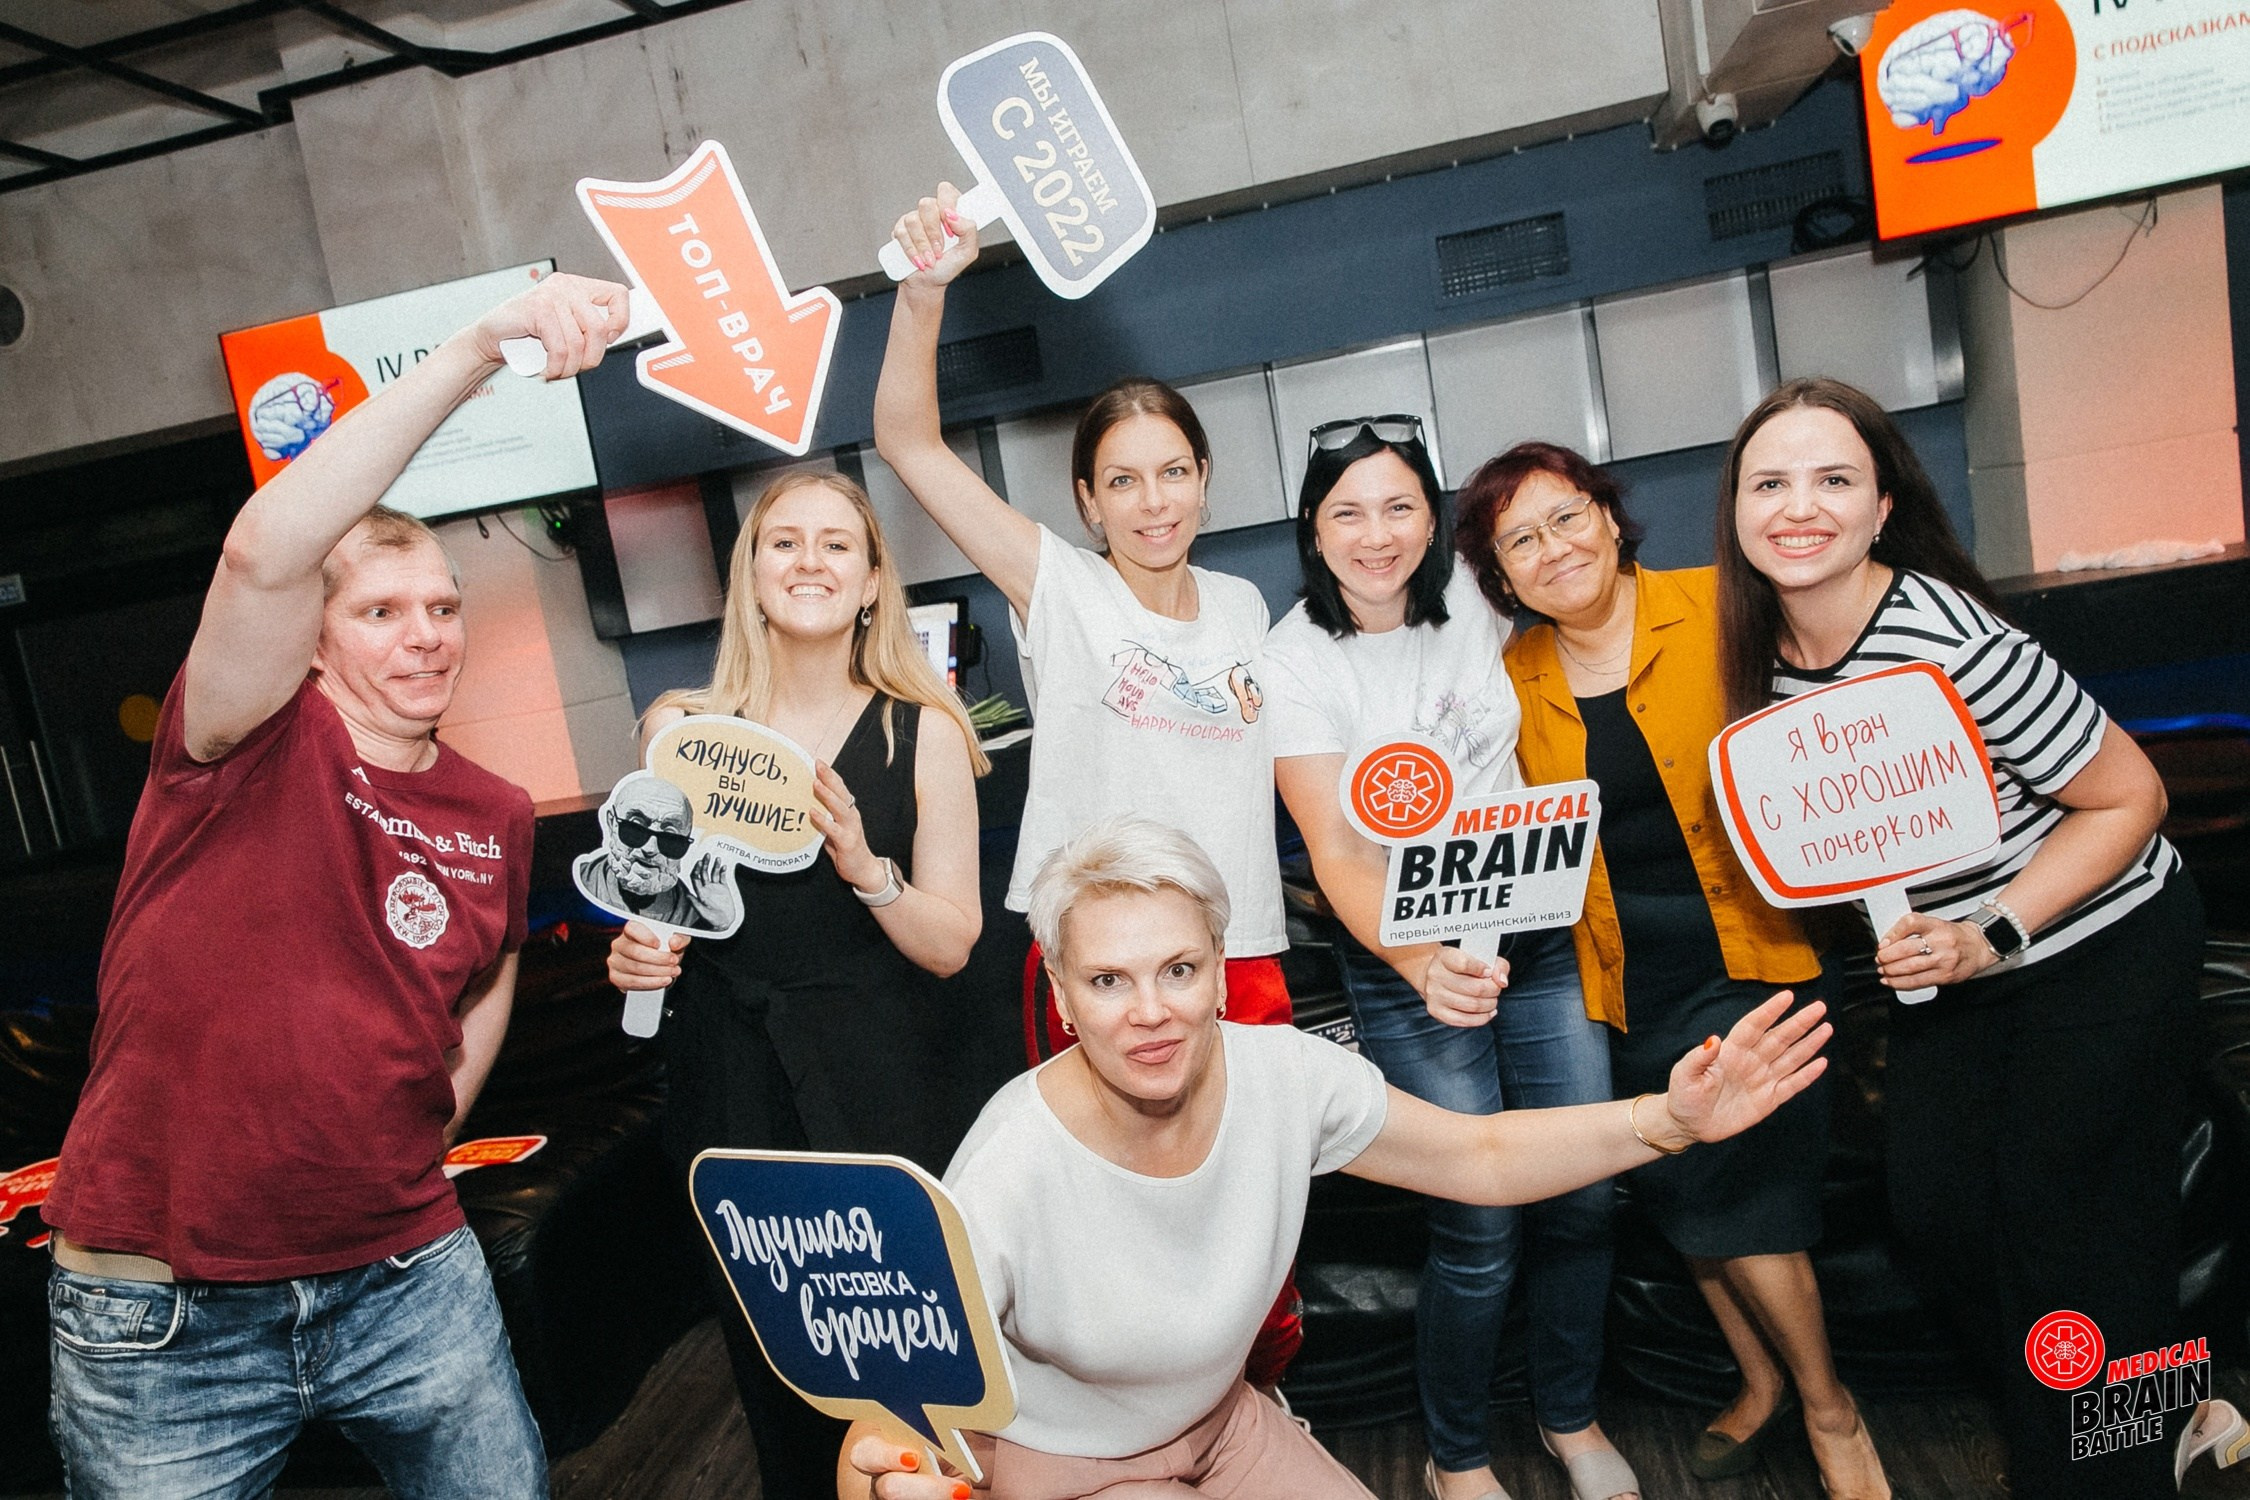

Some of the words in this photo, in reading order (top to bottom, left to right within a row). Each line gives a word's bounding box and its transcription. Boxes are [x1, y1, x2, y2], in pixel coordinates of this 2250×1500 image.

[1018, 56, 1060, 111] МЫ
[1048, 108, 1118, 215] ИГРАЕМ
[991, 96, 1035, 140] С
[1013, 140, 1105, 267] 2022
[668, 213, 792, 415] ТОП-ВРАЧ
[376, 353, 402, 383] IV
[1130, 714, 1176, 733] HAPPY
[1180, 722, 1244, 742] HOLIDAYS
[1813, 712, 1889, 763] врач
[676, 737, 788, 785] КЛЯНУСЬ,
[718, 775, 746, 792] ВЫ
[1792, 740, 1968, 823] ХОРОШИМ
[704, 792, 806, 833] ЛУЧШИЕ!
[1451, 792, 1590, 837] MEDICAL
[435, 835, 455, 853] &
[717, 840, 752, 860] КЛЯТВА
[752, 852, 811, 868] ГИППОКРАТА
[1397, 821, 1588, 893] BRAIN
[1800, 806, 1953, 867] почерком
[1393, 882, 1514, 922] BATTLE
[1390, 925, 1441, 942] первый
[1444, 912, 1537, 934] медицинский
[1539, 910, 1571, 922] квиз
[715, 1199, 882, 1292] Лучшая
[809, 1270, 917, 1297] ТУСОВКА
[800, 1282, 958, 1381] врачей
